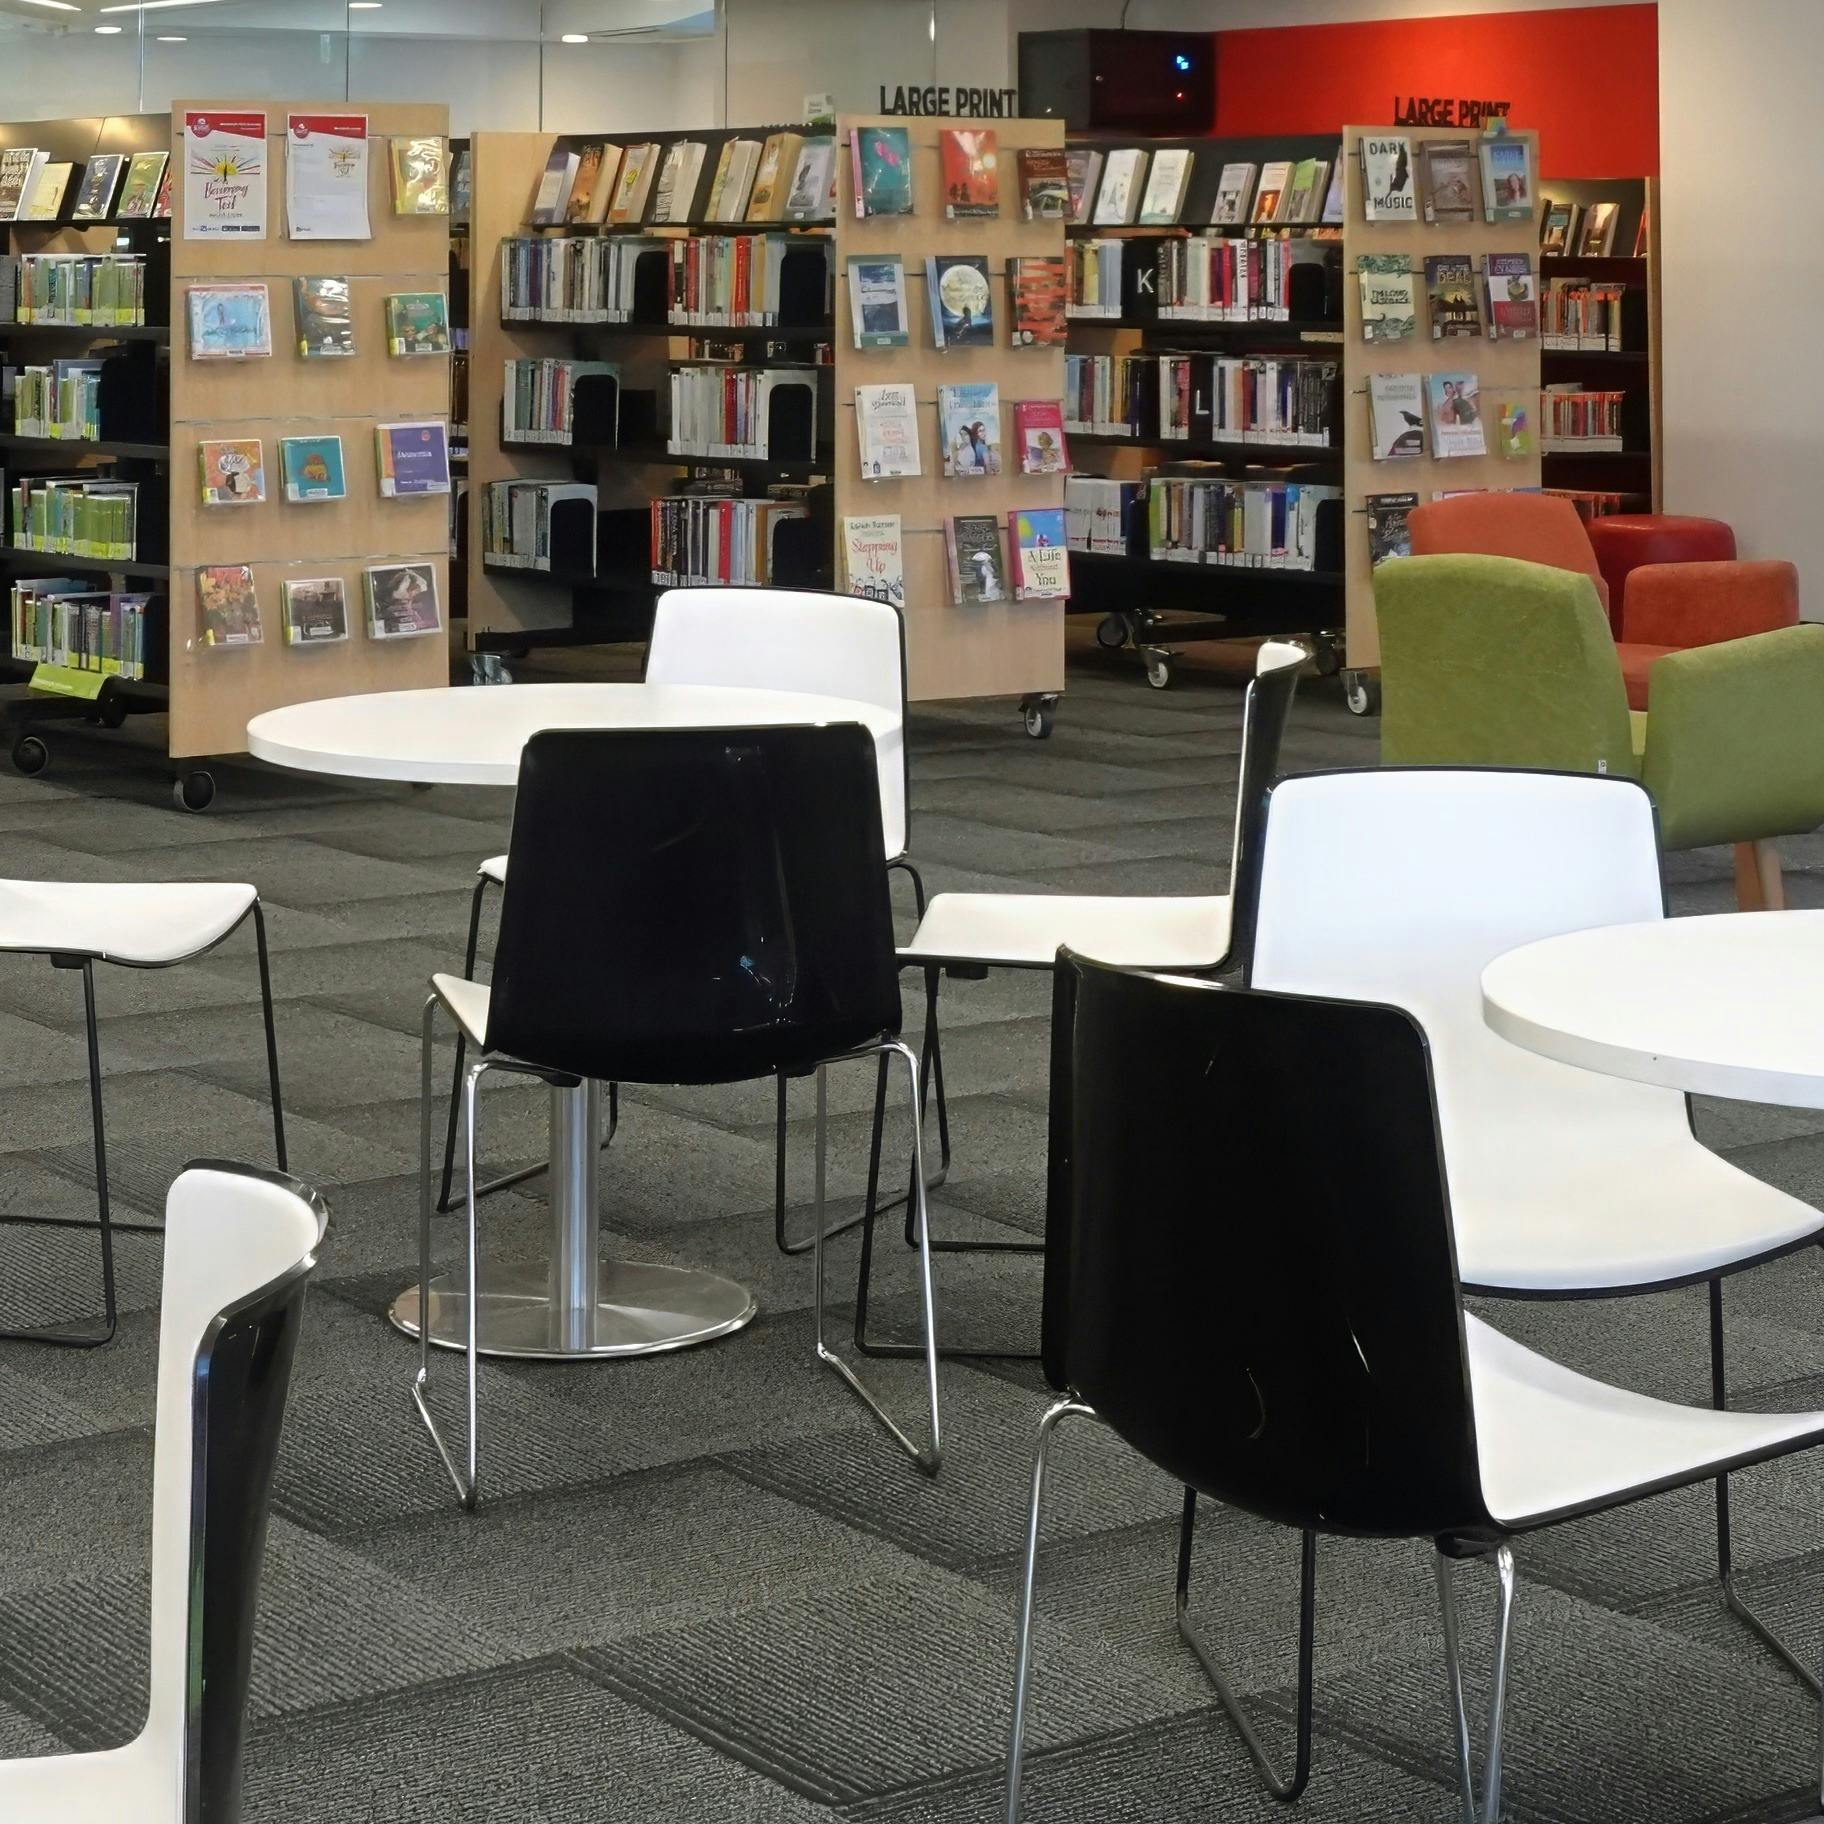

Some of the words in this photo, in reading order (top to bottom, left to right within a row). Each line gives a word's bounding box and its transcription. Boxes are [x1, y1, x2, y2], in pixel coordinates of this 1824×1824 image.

[880, 85, 950, 117] LARGE
[956, 88, 1017, 118] PRINT
[1394, 96, 1455, 127] LARGE
[1374, 196, 1413, 209] MUSIC
[1137, 268, 1155, 294] K
[1195, 388, 1210, 415] L
[852, 538, 898, 557] Stepping
[1039, 548, 1062, 562] Life
[866, 557, 886, 574] Up
[1036, 573, 1057, 586] You
